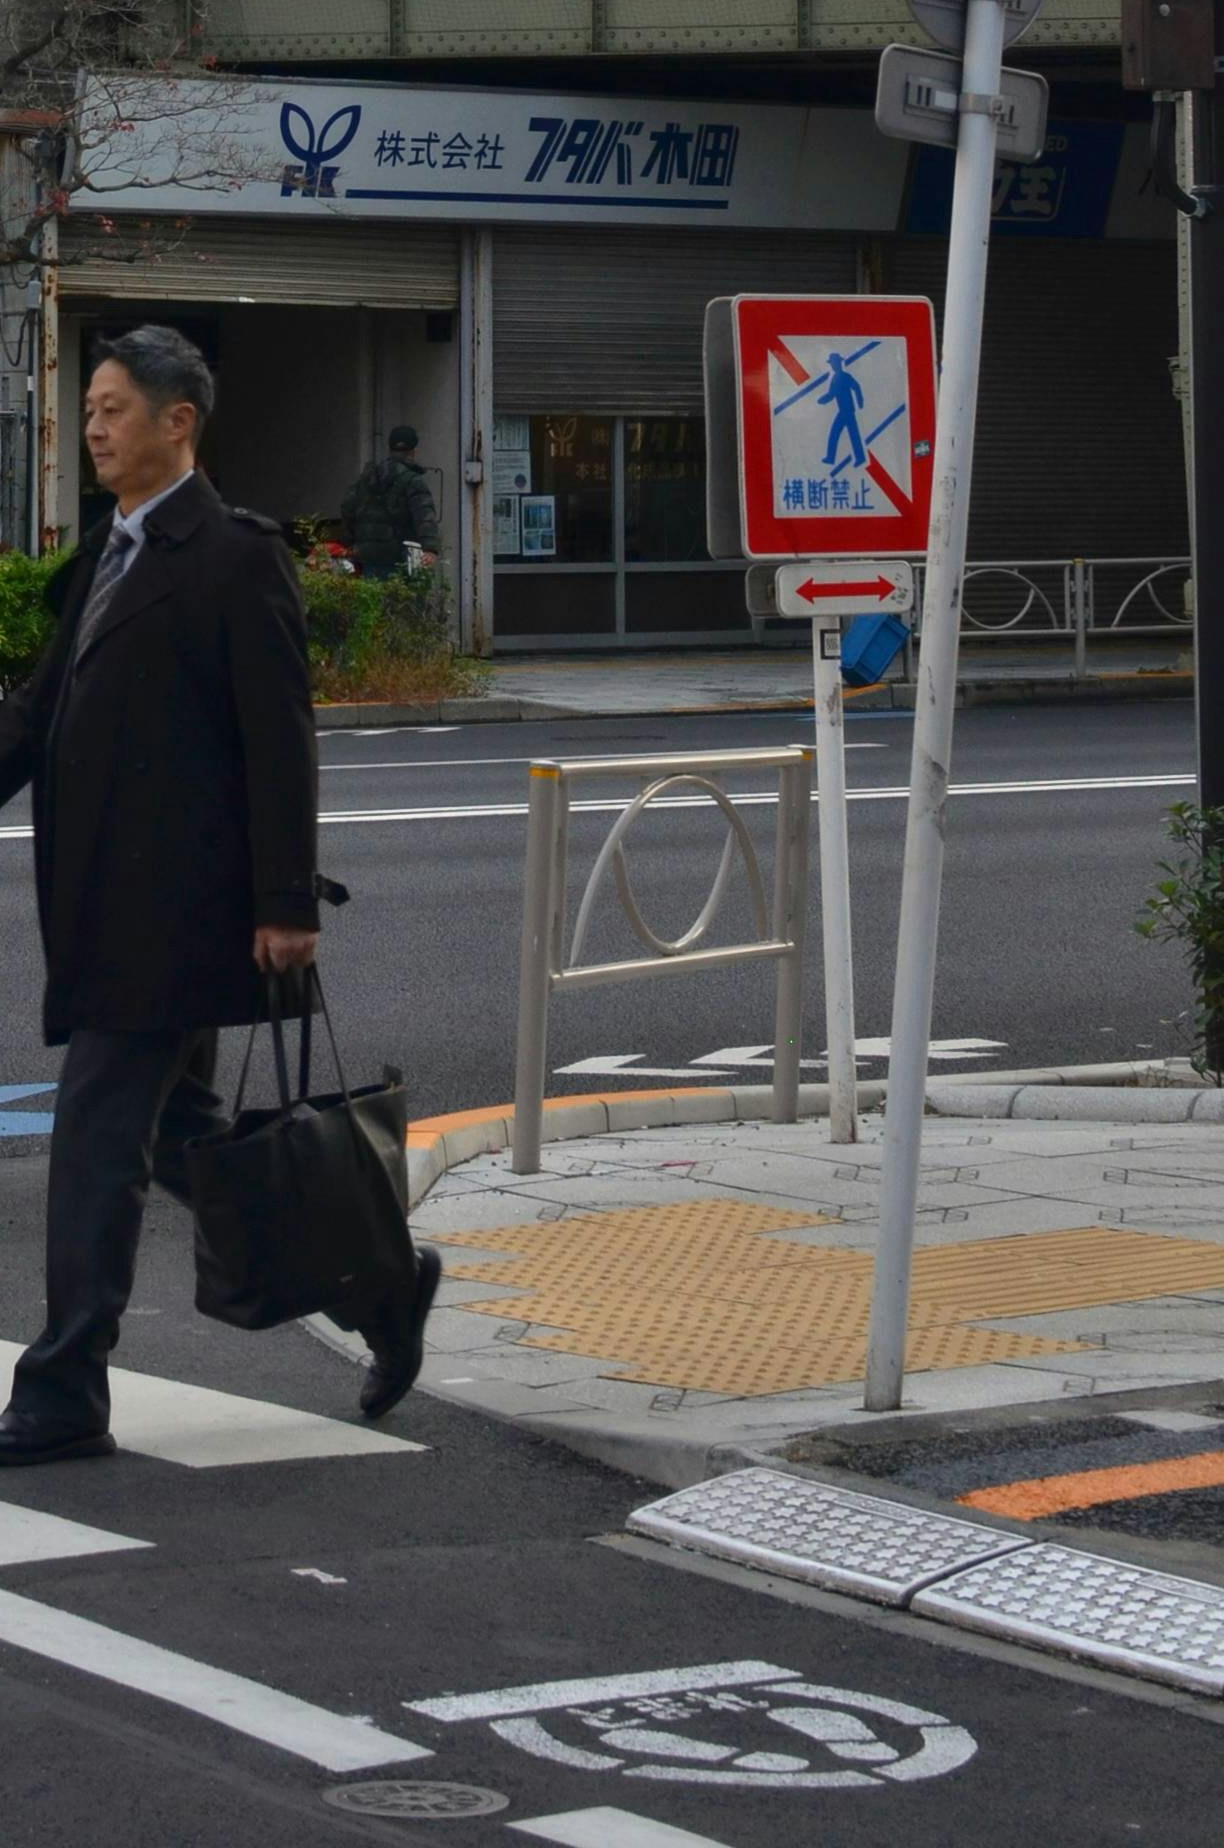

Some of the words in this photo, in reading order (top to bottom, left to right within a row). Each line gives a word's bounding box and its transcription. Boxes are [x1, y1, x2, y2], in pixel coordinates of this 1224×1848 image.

[374, 129, 505, 170] 株式会社
[783, 478, 875, 512] 横断禁止
